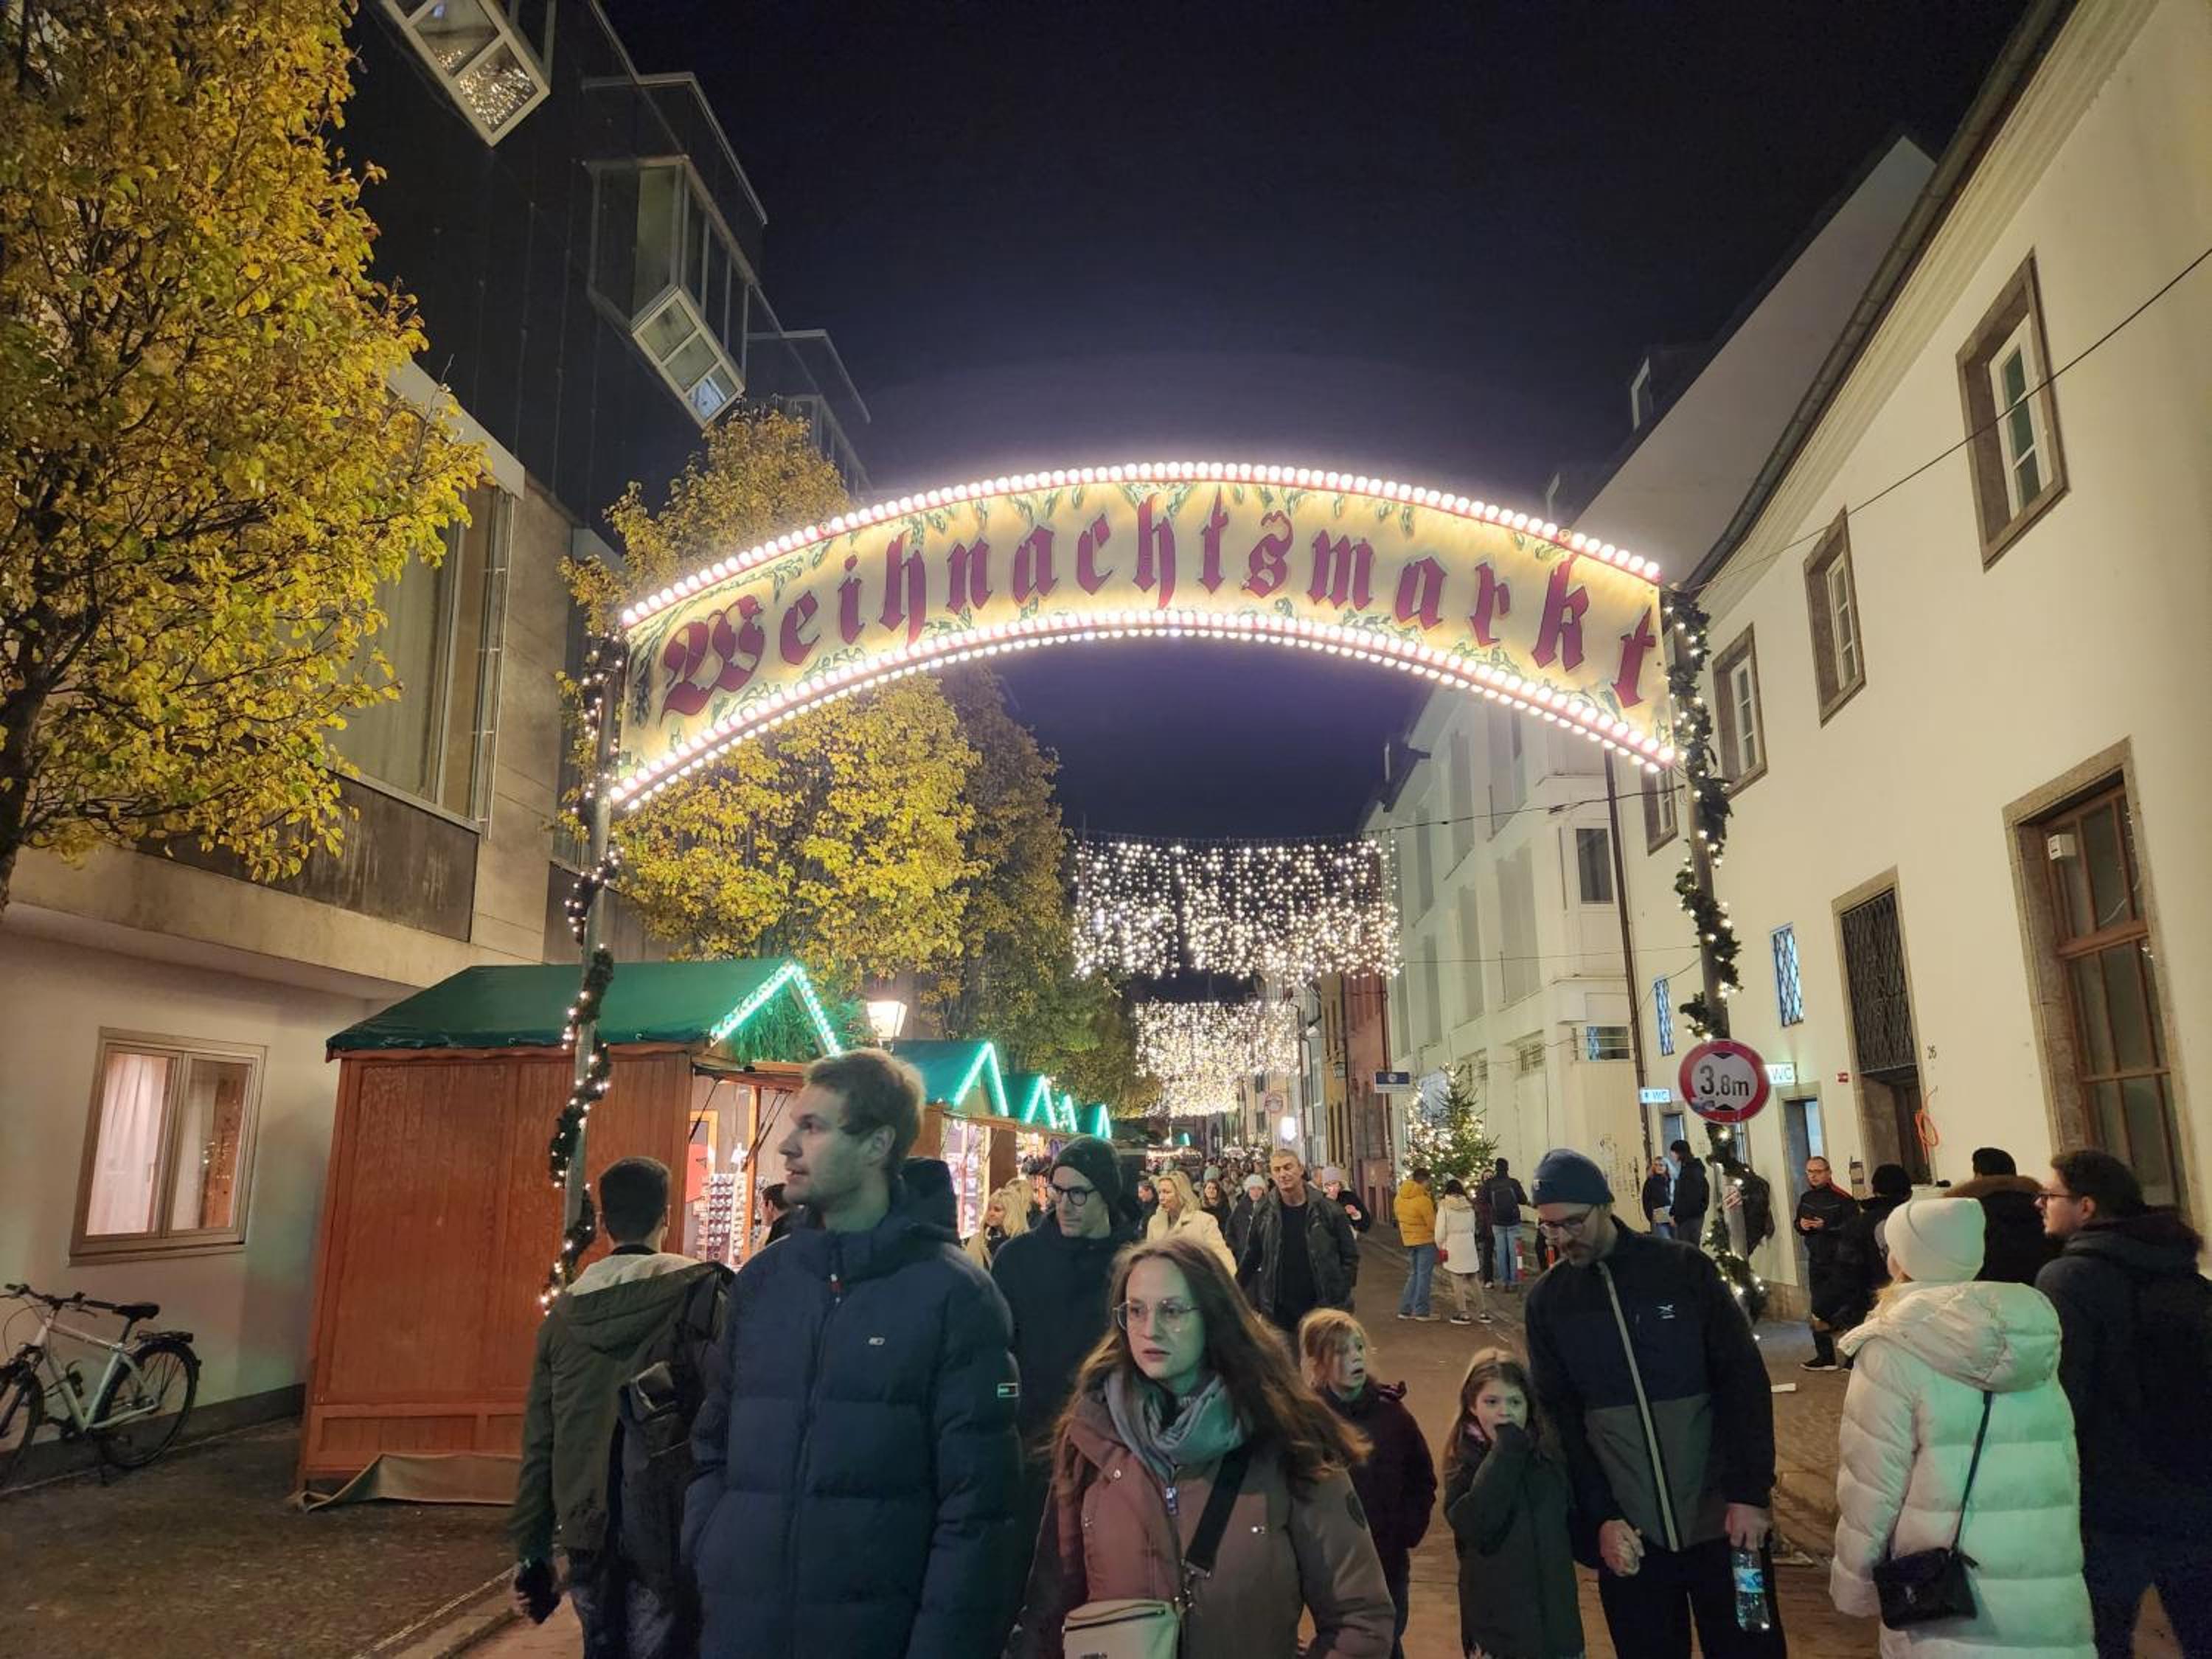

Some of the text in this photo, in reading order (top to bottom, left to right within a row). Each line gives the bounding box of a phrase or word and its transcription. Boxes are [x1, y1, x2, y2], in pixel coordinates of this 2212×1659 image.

[661, 484, 1657, 721] Weihnachtsmarkt
[1771, 1067, 1792, 1081] WC
[1652, 1091, 1667, 1101] WC
